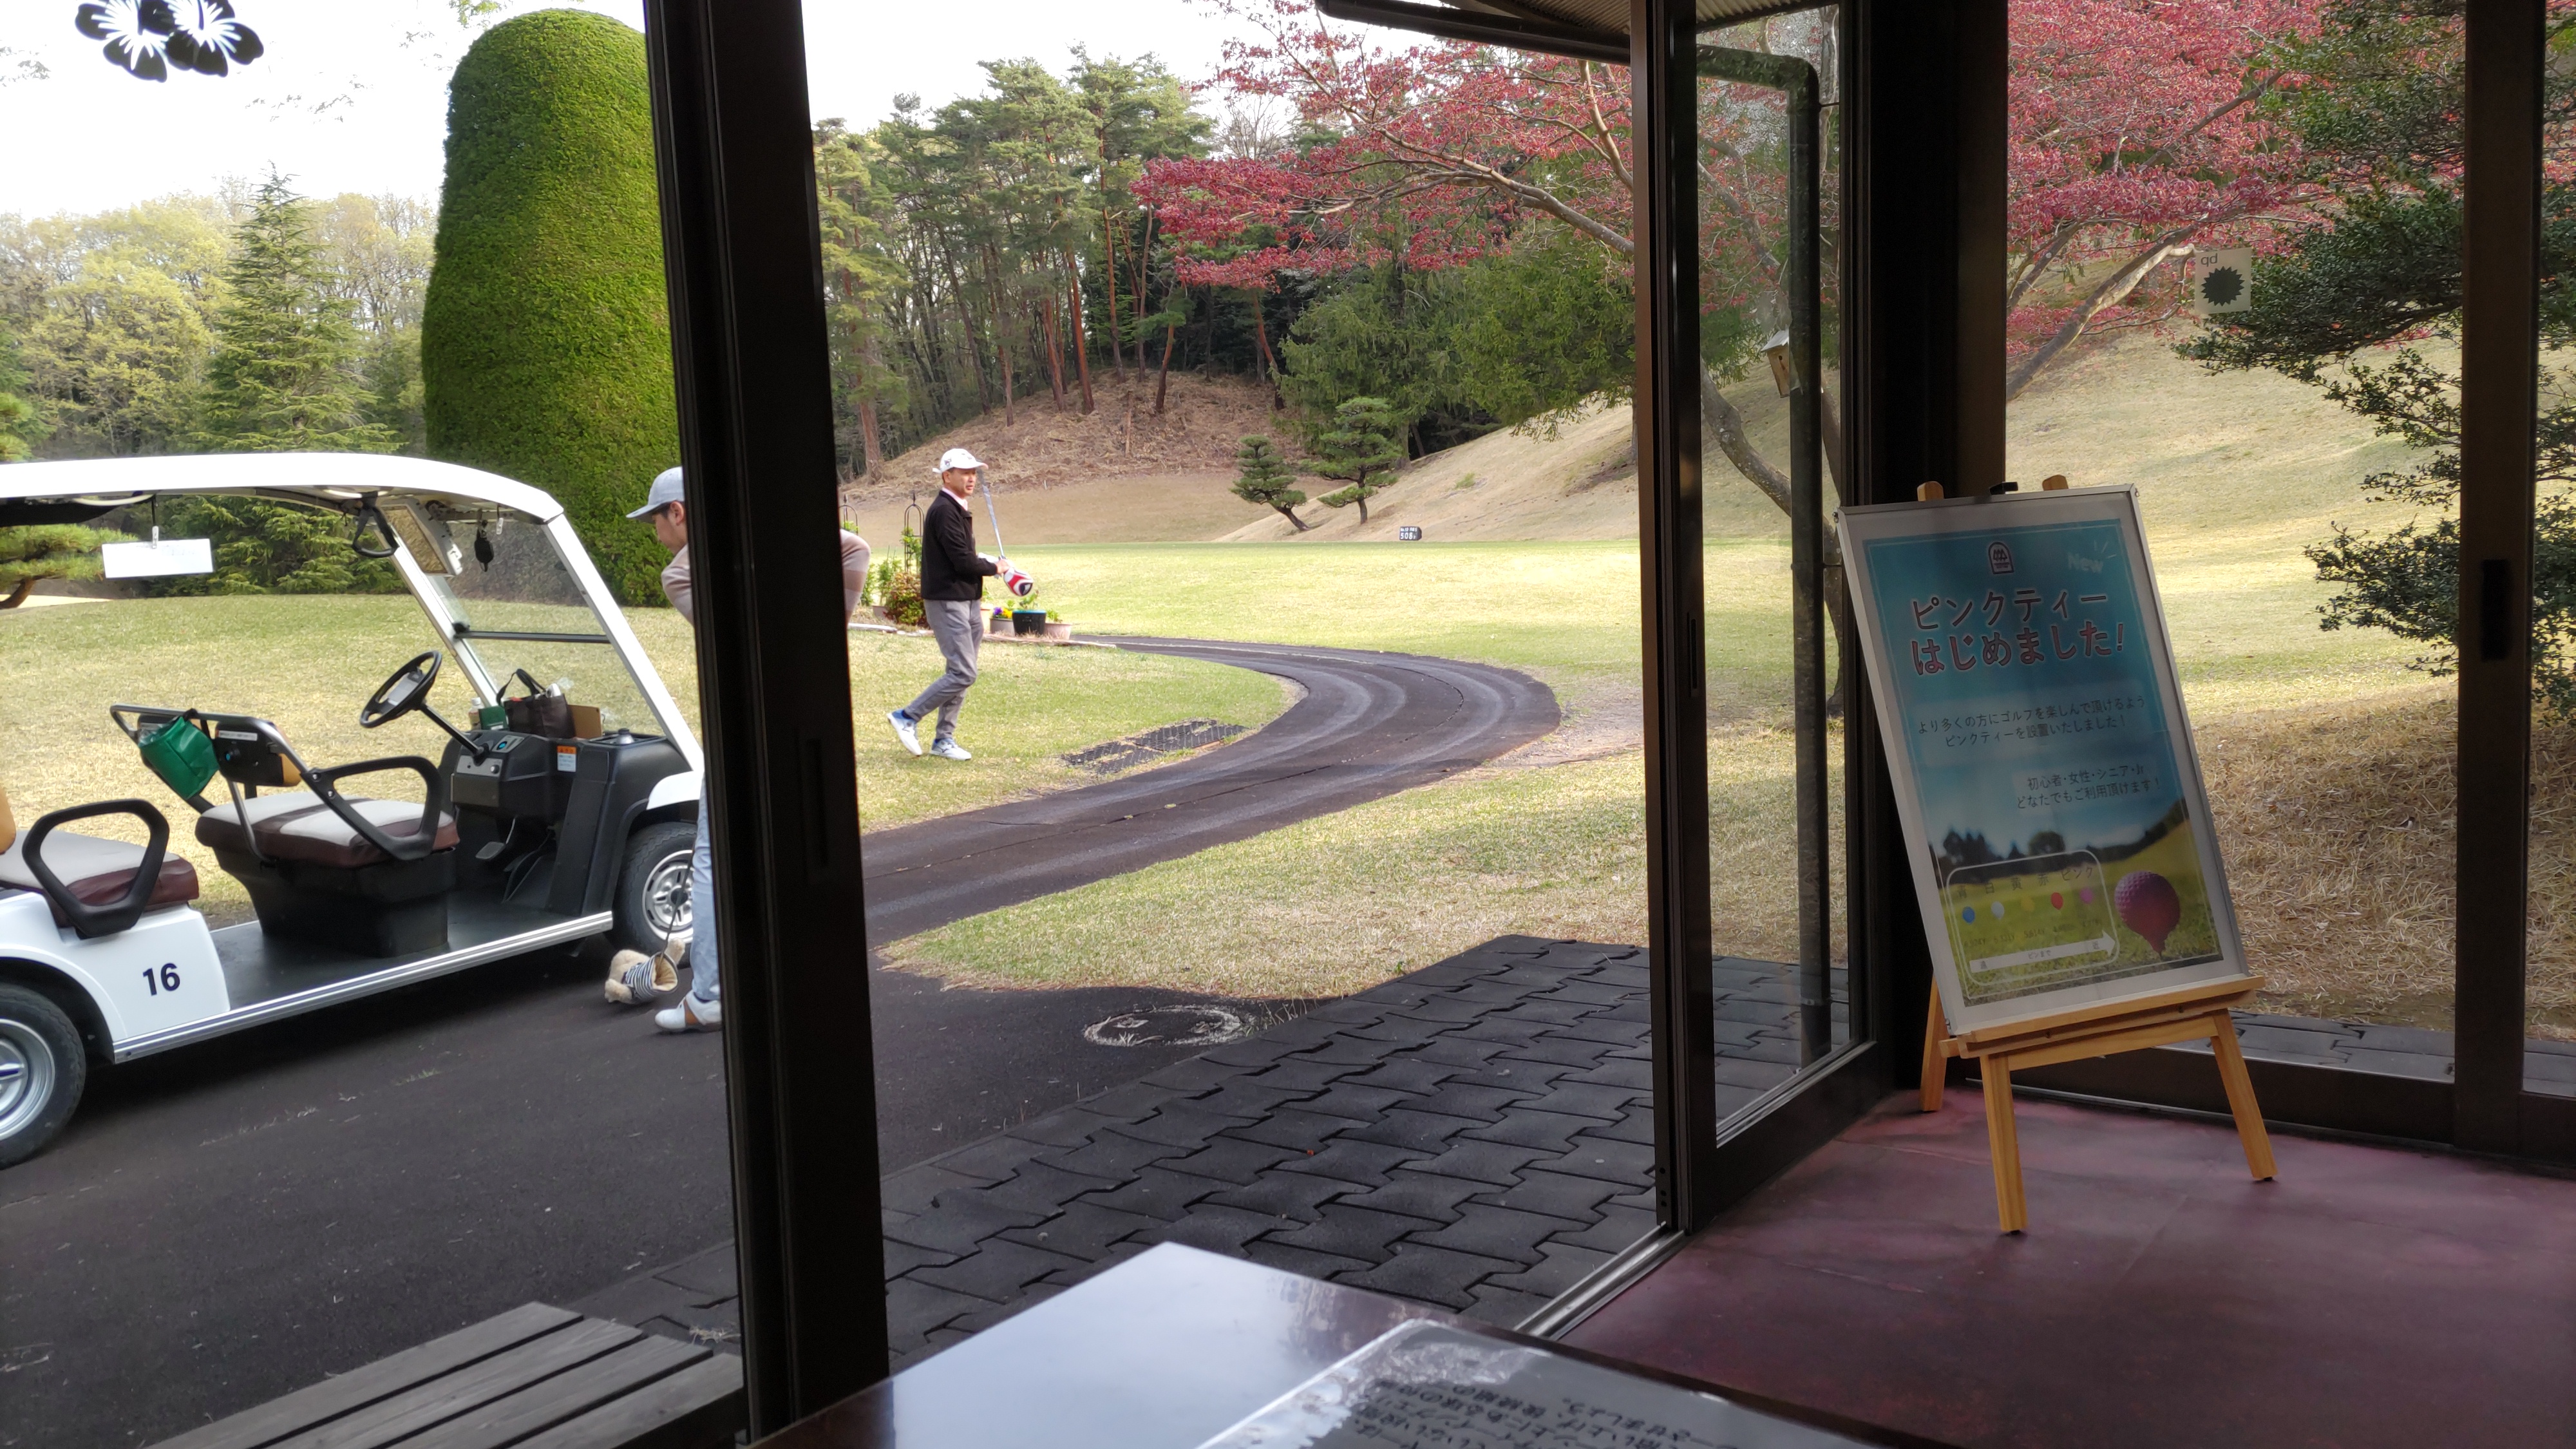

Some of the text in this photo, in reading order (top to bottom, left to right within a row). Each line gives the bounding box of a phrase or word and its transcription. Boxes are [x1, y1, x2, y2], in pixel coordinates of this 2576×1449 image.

[2067, 553, 2104, 573] New
[1913, 589, 2107, 630] ピンクティー
[1911, 621, 2124, 676] はじめました!
[1918, 696, 2145, 734] より多くの方にゴルフを楽しんで頂けるよう
[2061, 866, 2094, 882] ピンク
[142, 962, 180, 996] 16
